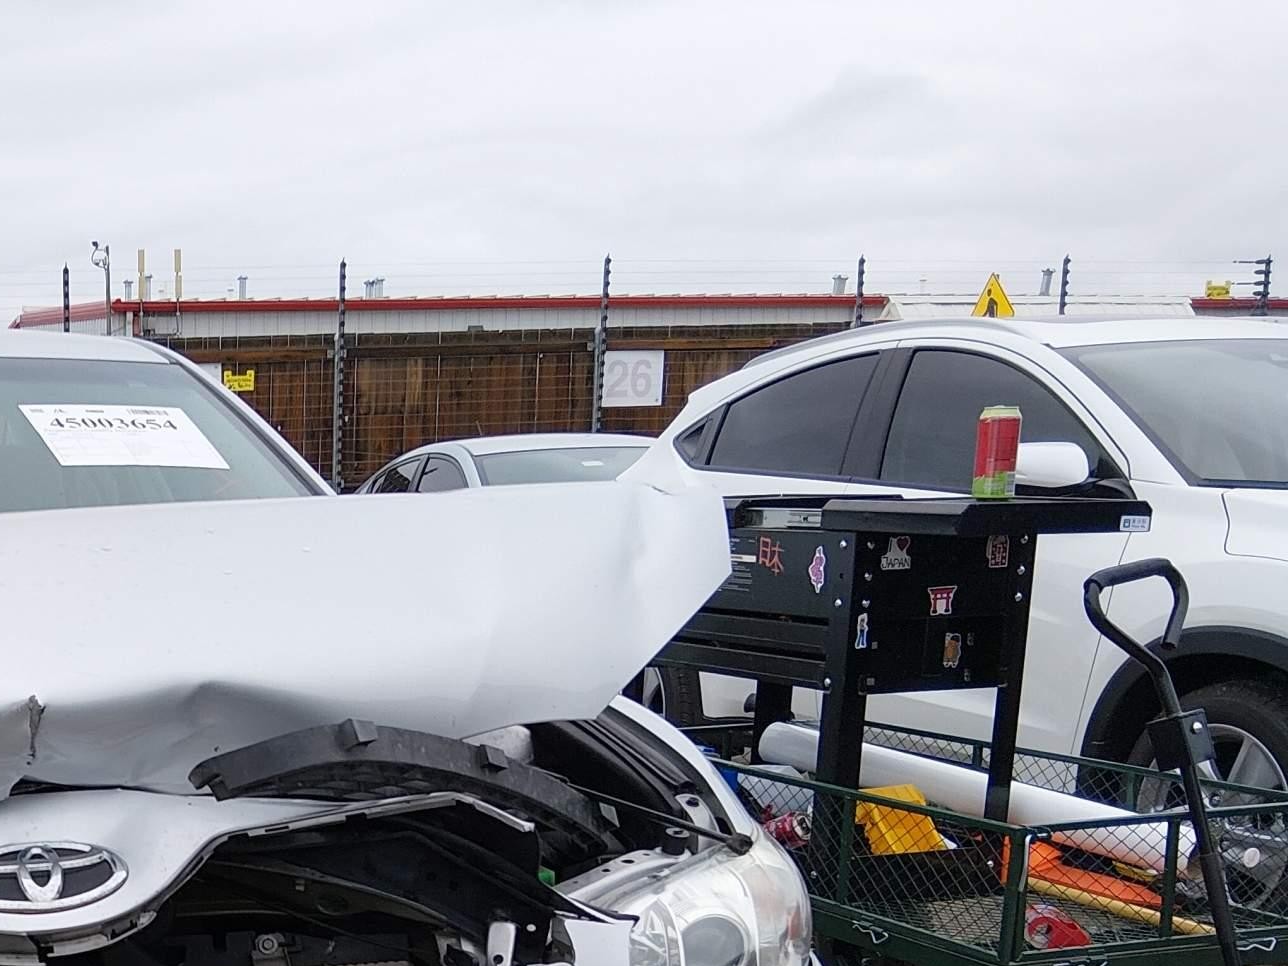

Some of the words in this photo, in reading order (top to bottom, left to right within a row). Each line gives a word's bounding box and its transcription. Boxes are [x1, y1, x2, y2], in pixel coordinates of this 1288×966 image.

[605, 359, 652, 398] 26
[50, 417, 178, 431] 45003654
[881, 556, 911, 569] JAPAN
